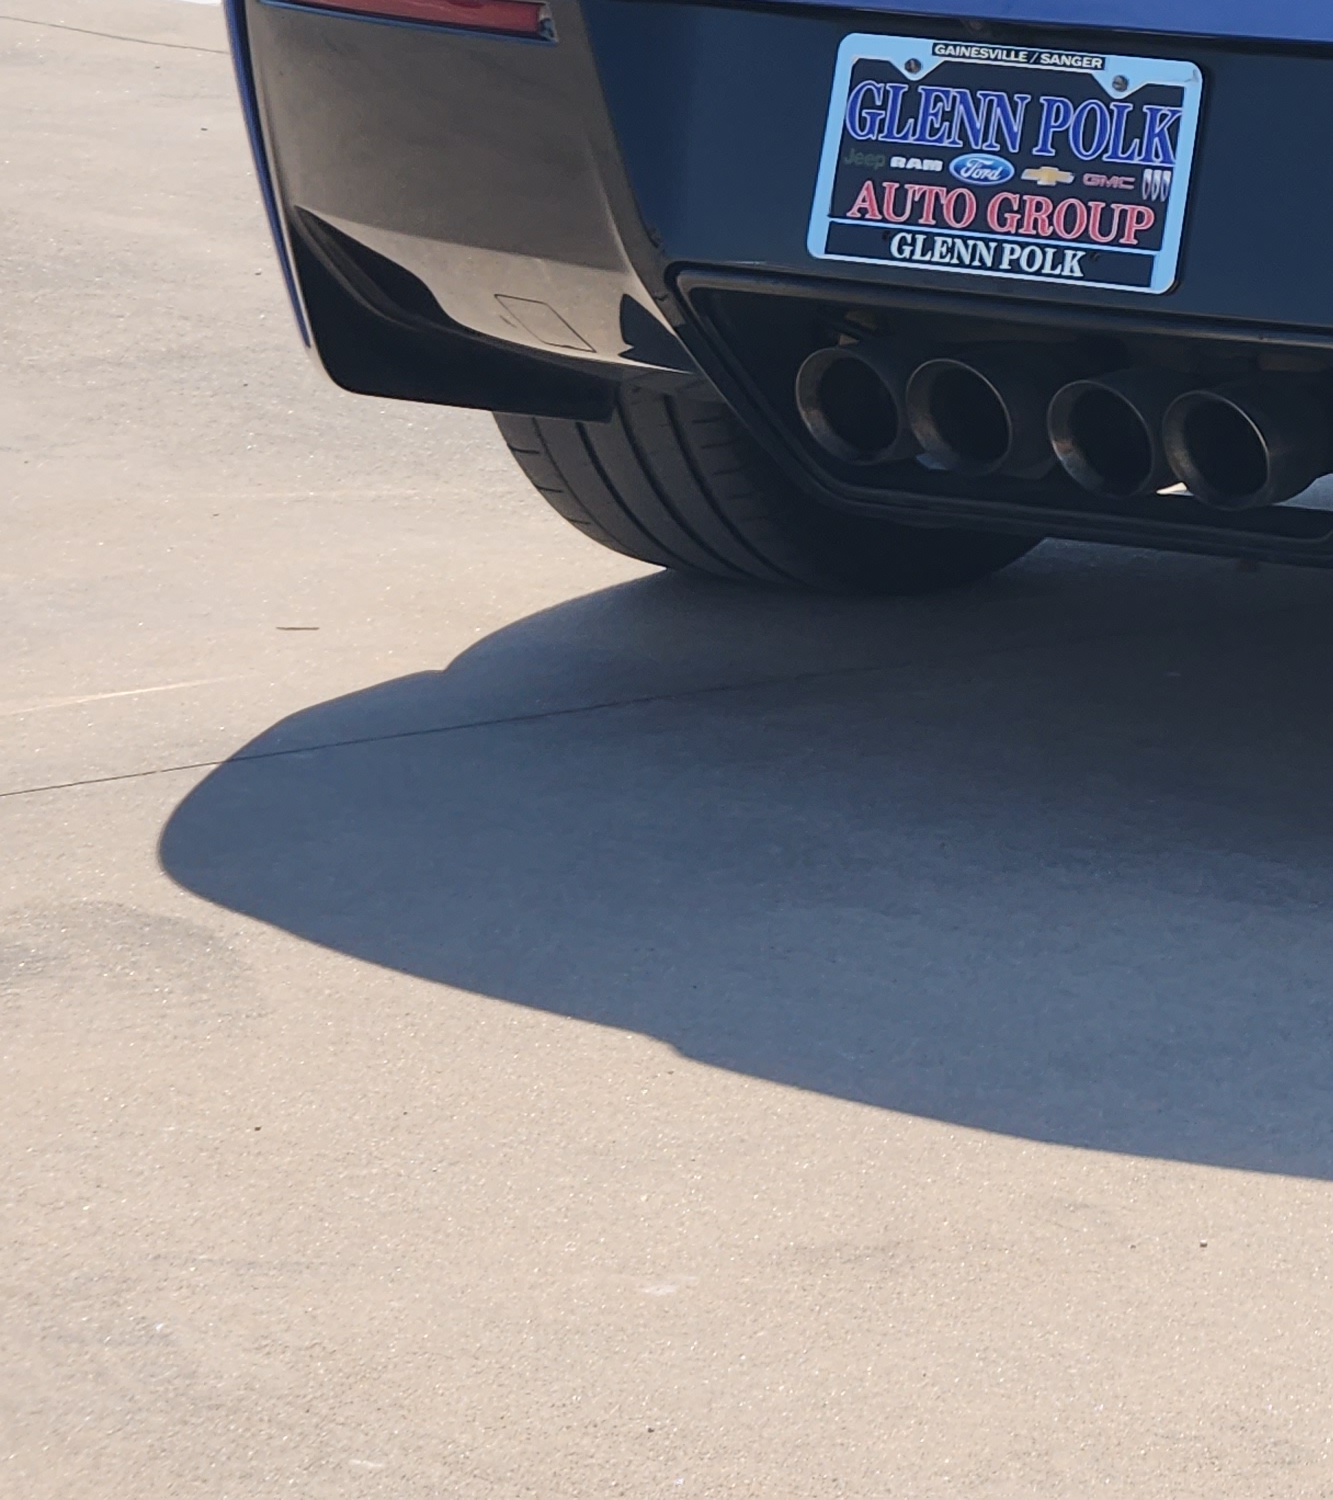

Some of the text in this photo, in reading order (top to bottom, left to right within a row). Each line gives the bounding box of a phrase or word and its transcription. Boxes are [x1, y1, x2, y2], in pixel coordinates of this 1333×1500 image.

[935, 44, 1028, 62] GAINESVILLE
[1040, 53, 1103, 68] SANGER
[845, 80, 1183, 167] GLENN POLK
[844, 148, 1136, 190] Jeep RAM Ford GMC
[846, 181, 1156, 246] AUTO GROUP
[890, 231, 1085, 278] GLENN POLK
